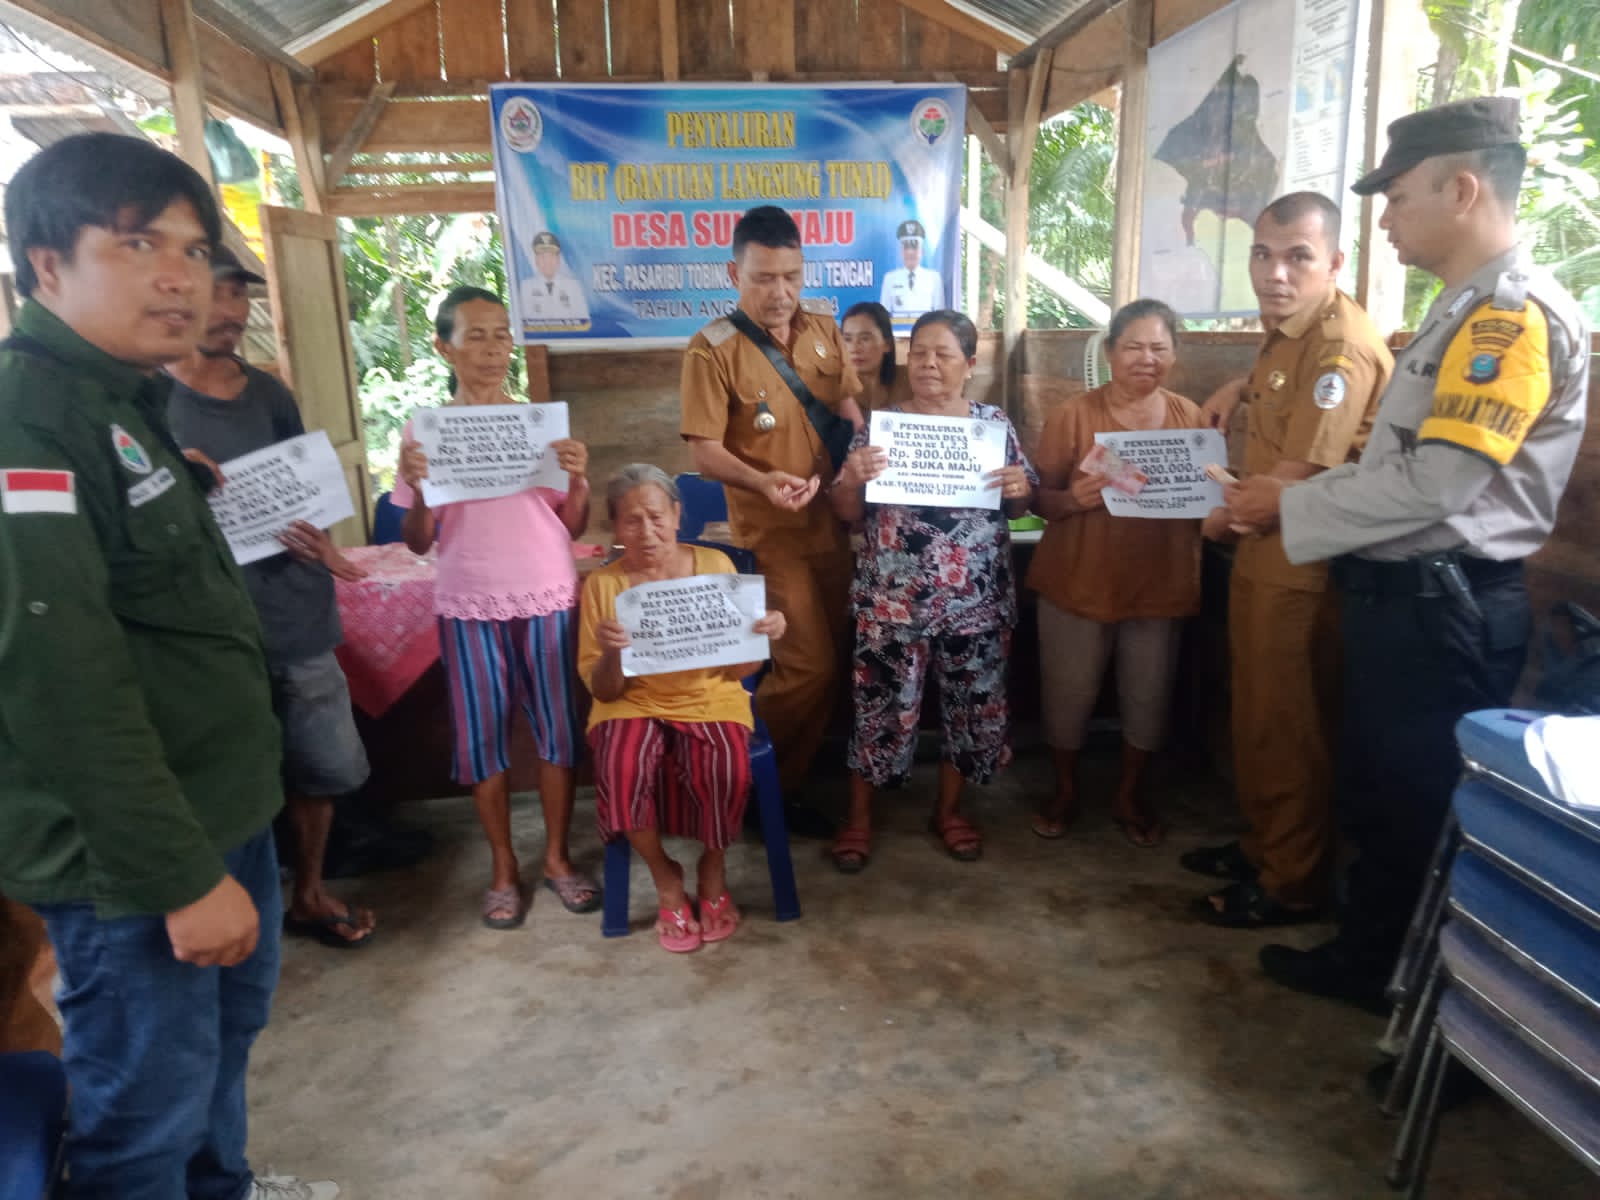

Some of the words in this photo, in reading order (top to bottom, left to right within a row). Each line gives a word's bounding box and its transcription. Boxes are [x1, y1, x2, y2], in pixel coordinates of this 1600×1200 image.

[667, 111, 796, 148] PENYALURAN
[570, 162, 608, 201] BLT
[614, 162, 715, 205] (BANTUAN
[720, 161, 821, 200] LANGSUNG
[826, 160, 892, 202] TUNAI)
[613, 211, 688, 249] DESA
[692, 210, 743, 248] SU
[592, 263, 621, 292] KEC.
[624, 262, 683, 291] PASARIBU
[825, 259, 874, 289] TENGAH
[635, 300, 693, 319] TAHUN
[900, 423, 965, 434] PENYALURAN
[893, 431, 911, 439] BLT
[913, 432, 940, 441] DANA
[943, 434, 968, 443] DESA
[430, 457, 463, 467] DESA
[465, 454, 504, 465] SUKA
[507, 452, 545, 462] MAJU
[889, 447, 910, 459] Rp.
[888, 461, 908, 469] ESA
[911, 461, 945, 470] SUKA
[948, 462, 982, 473] MAJU
[1147, 475, 1170, 485] UKA
[1173, 473, 1207, 484] MAJU
[647, 583, 719, 599] PENYALURAN
[632, 630, 663, 640] DESA
[667, 625, 703, 637] SUKA
[706, 617, 742, 630] MAJU
[640, 618, 663, 630] Rp.
